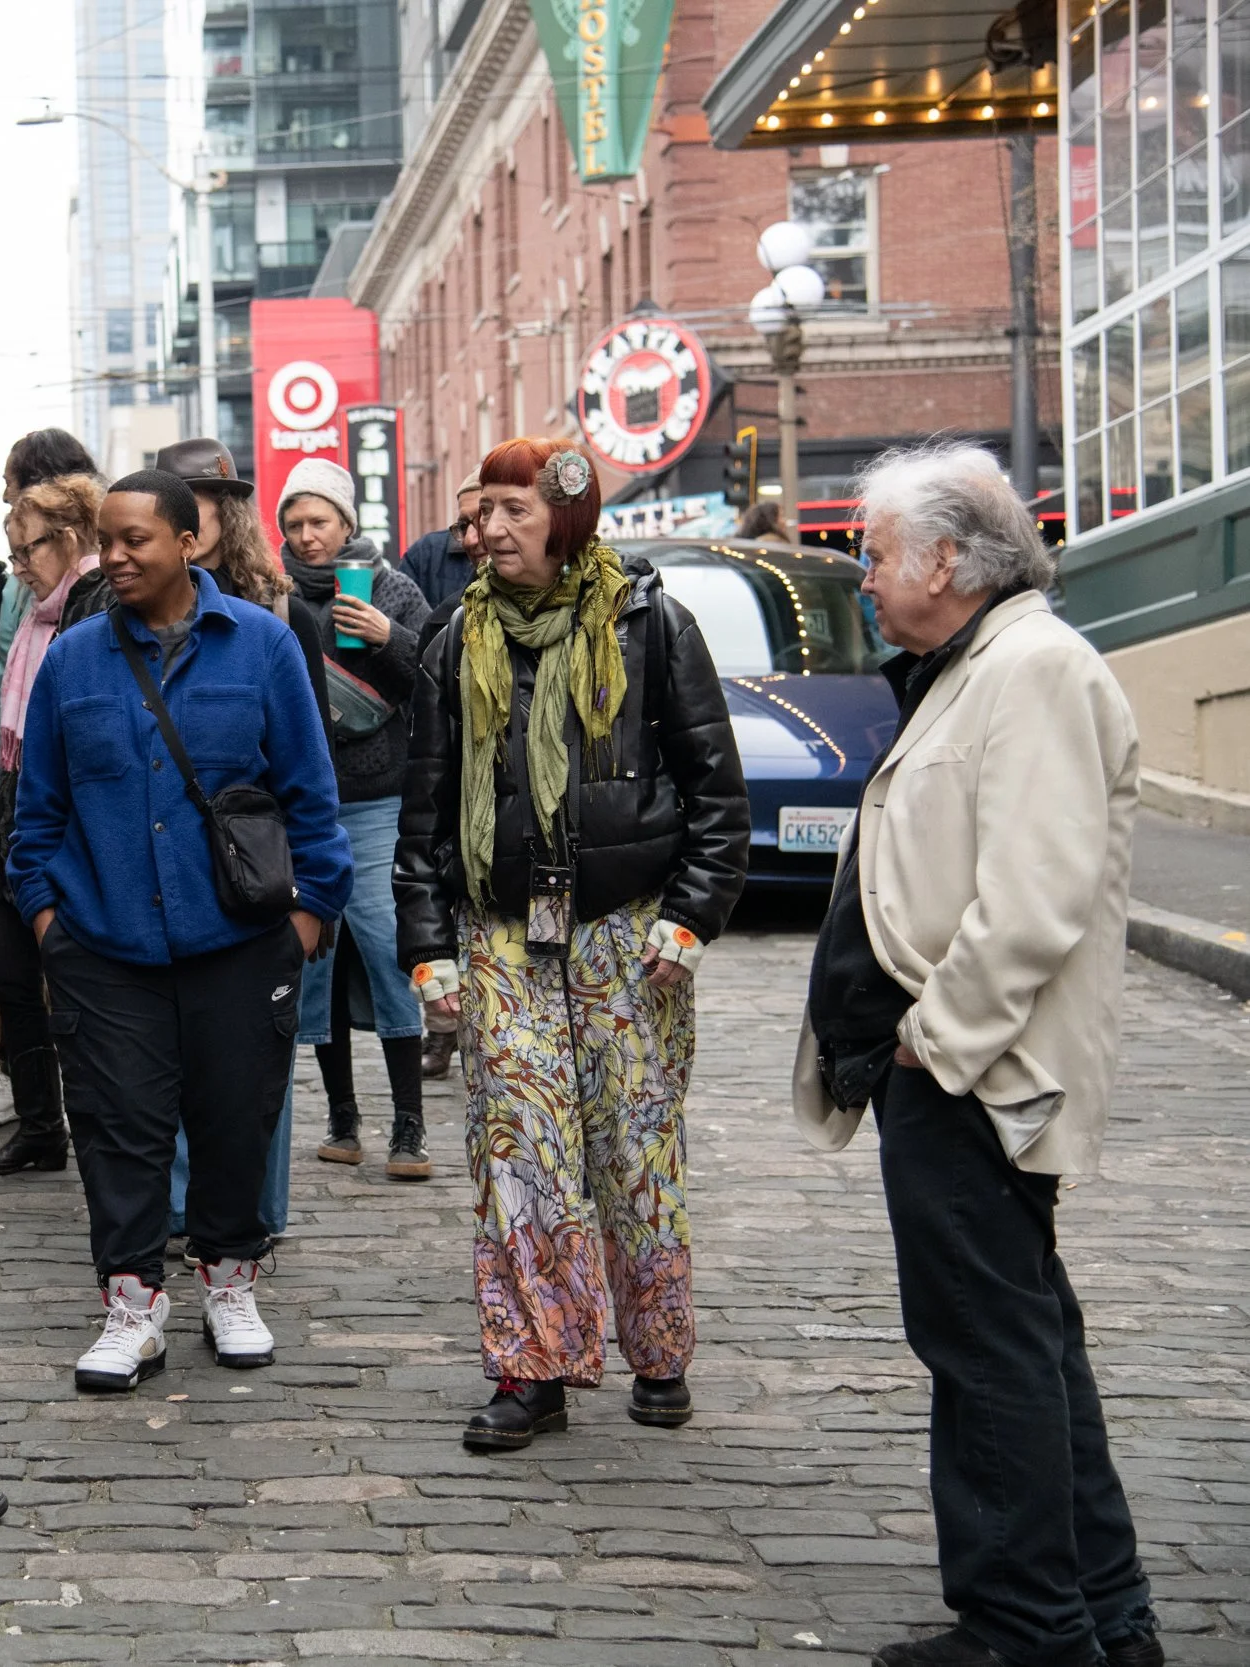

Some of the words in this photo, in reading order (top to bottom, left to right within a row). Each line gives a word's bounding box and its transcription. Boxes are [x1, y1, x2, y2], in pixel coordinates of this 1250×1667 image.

[584, 323, 696, 394] SEATTLE
[270, 426, 339, 454] target
[586, 409, 664, 464] SHIRT
[356, 422, 391, 571] SHIRT
[785, 823, 847, 845] CKE52
